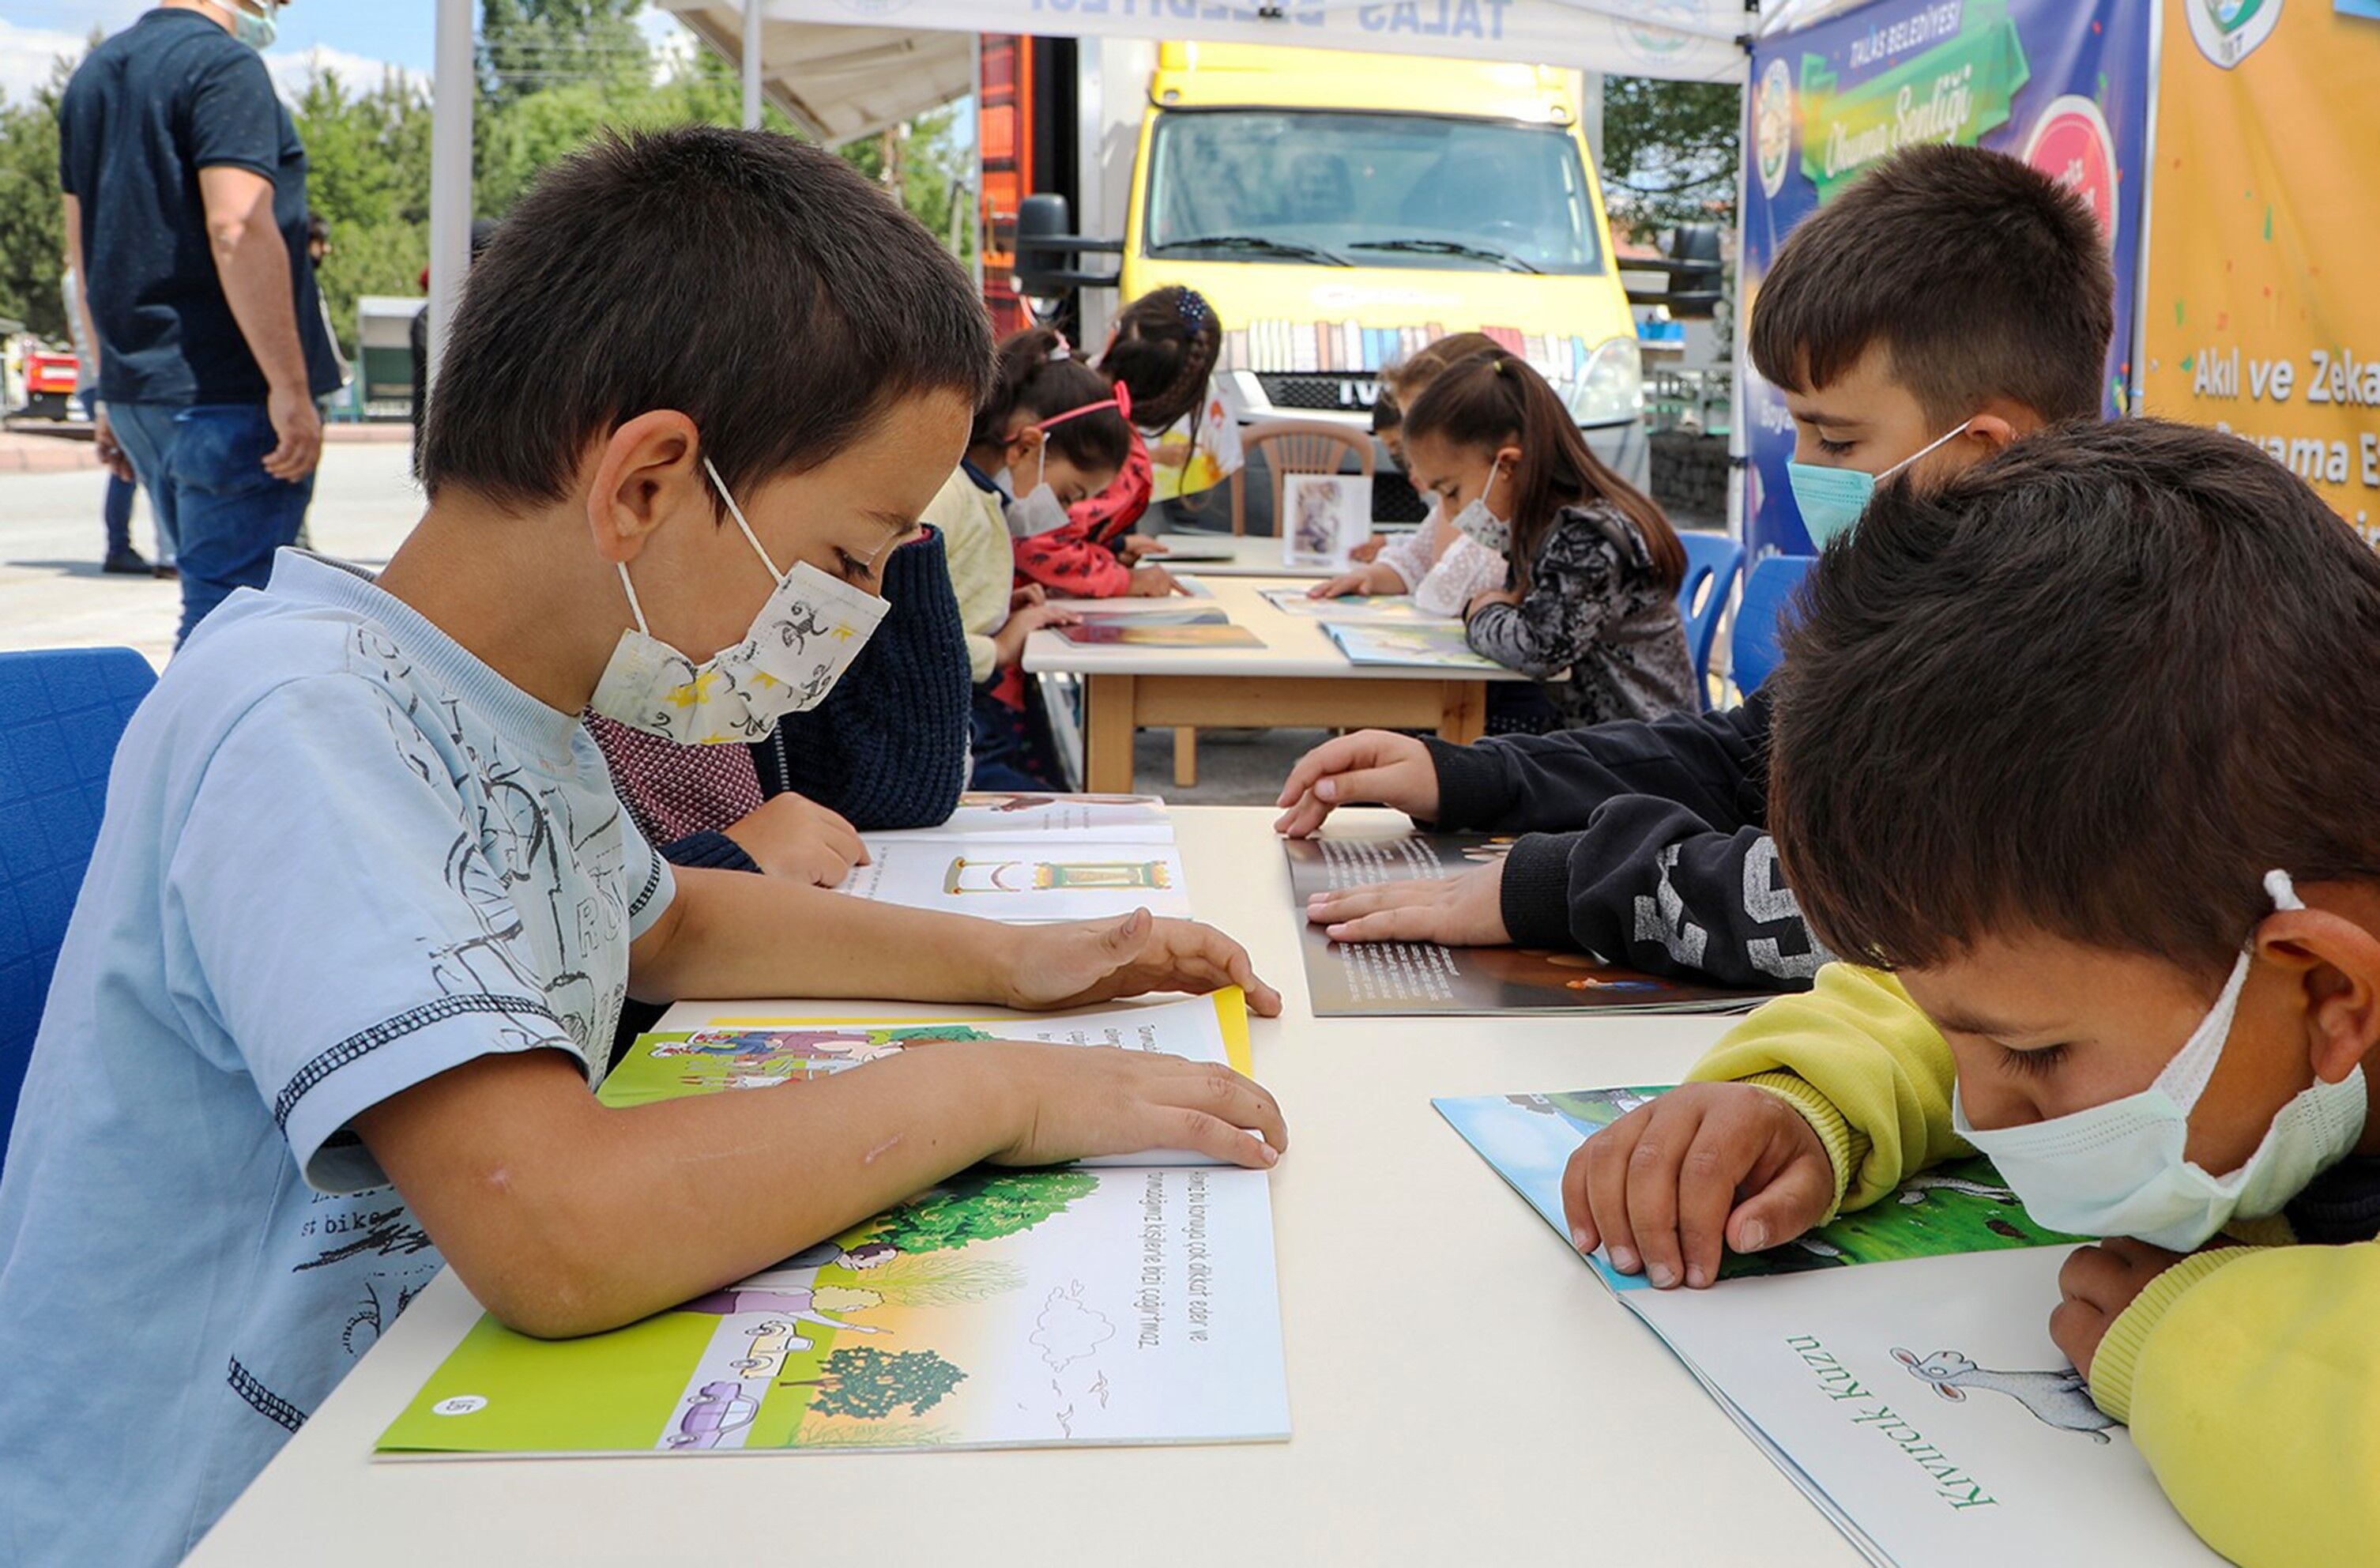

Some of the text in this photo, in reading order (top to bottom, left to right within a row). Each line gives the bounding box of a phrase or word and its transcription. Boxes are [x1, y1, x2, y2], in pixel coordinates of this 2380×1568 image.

[2193, 347, 2239, 398] Akıl
[2249, 359, 2294, 401] ve
[325, 1209, 382, 1234] bike
[1183, 1242, 1212, 1262] çok
[1141, 1265, 1166, 1286] bizi
[1188, 1264, 1212, 1297] dikkat
[1188, 1301, 1213, 1327] eder
[1189, 1329, 1209, 1342] ve
[1785, 1334, 2000, 1511] Kıvırcık Kuzu
